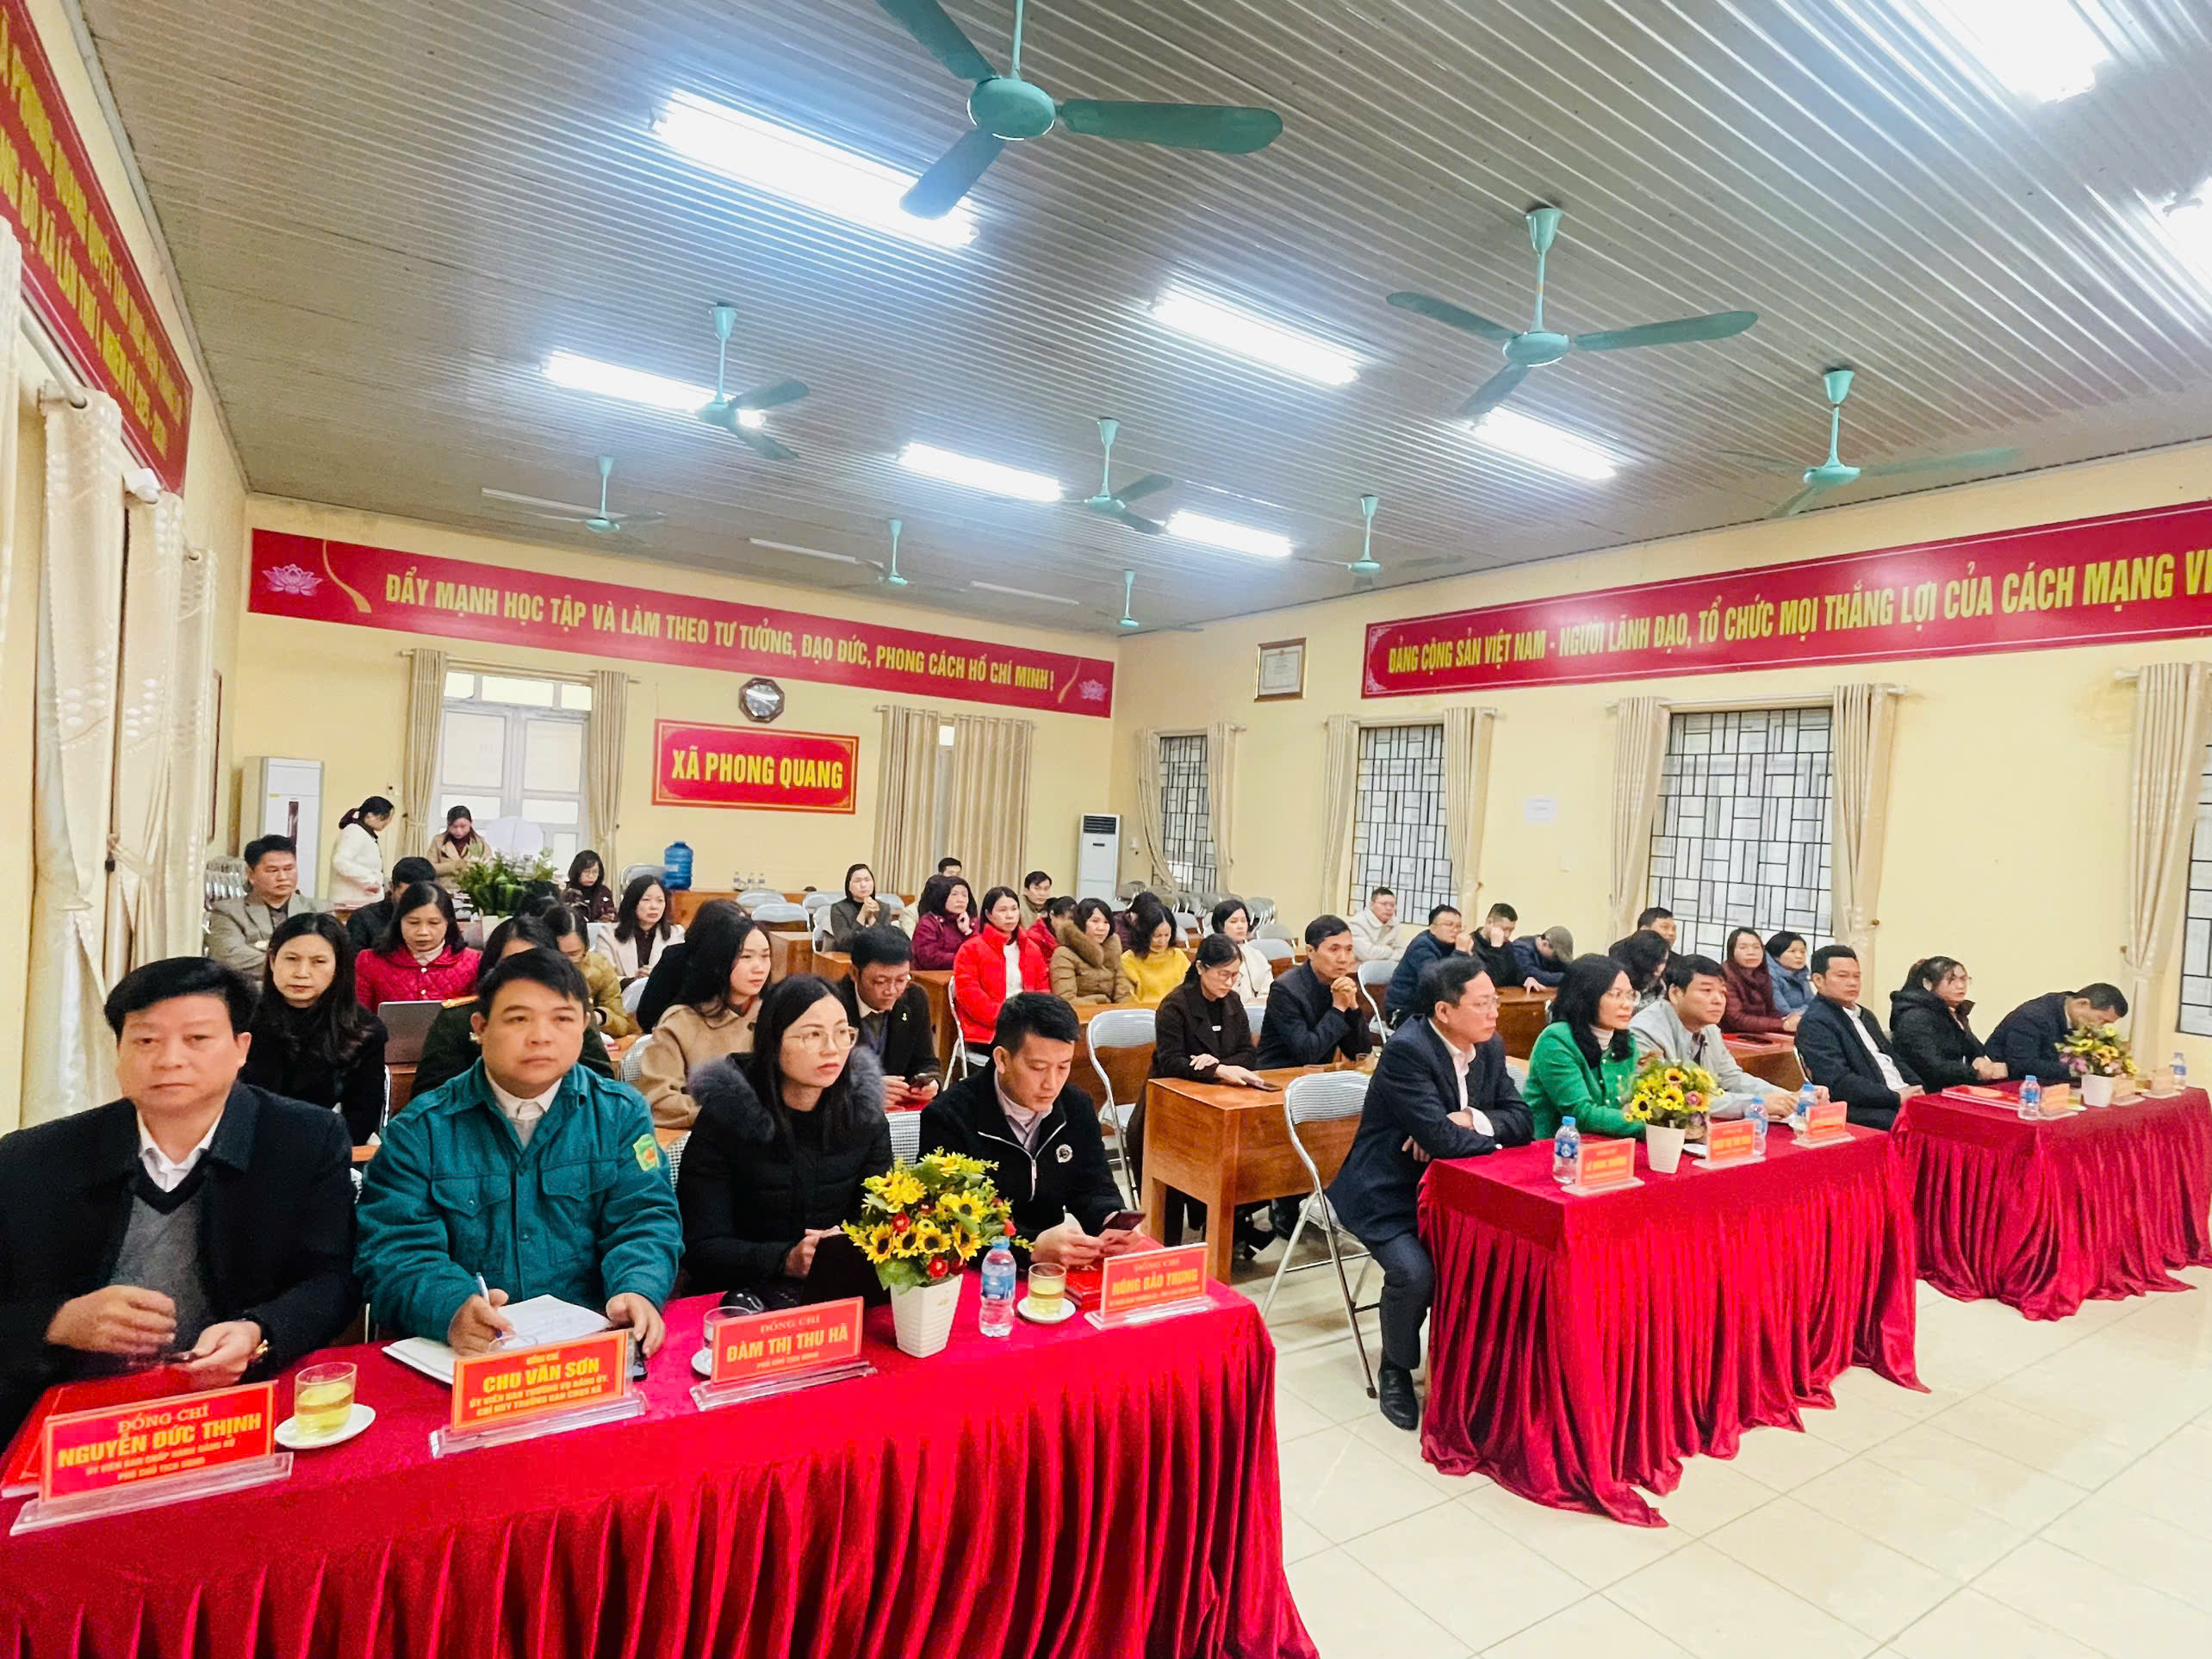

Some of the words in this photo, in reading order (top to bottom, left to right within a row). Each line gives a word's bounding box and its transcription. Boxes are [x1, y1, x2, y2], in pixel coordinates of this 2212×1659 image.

[385, 567, 428, 605] ĐẨY
[435, 581, 498, 618] MẠNH
[504, 592, 544, 624] HỌC
[550, 597, 587, 631] TẬP
[592, 600, 617, 631] VÀ
[621, 603, 660, 637] LÀM
[666, 612, 709, 643] THEO
[714, 620, 737, 648] TƯ
[739, 618, 797, 658] TƯỞNG,
[801, 635, 833, 664] ĐẠO
[837, 634, 872, 669] ĐỨC,
[876, 645, 924, 674] PHONG
[929, 650, 965, 680] CÁCH
[968, 653, 987, 681] HỒ
[990, 660, 1012, 686] CHÍ
[1388, 636, 1418, 674] ĐẢNG
[1421, 637, 1453, 675] CỘNG
[1456, 627, 1482, 667] SẢN
[1483, 627, 1512, 669] VIỆT
[1513, 630, 1545, 662] NAM
[1558, 615, 1605, 657] NGƯỜI
[1607, 614, 1649, 652] LÃNH
[1653, 612, 1692, 655] ĐẠO,
[1698, 595, 1723, 643] TỔ
[1724, 594, 1774, 640] CHỨC
[1780, 593, 1817, 642] MỌI
[1824, 579, 1893, 631] THẮNG
[1900, 581, 1936, 632] LỢI
[1944, 562, 1993, 620] CỦA
[2001, 561, 2075, 614] CÁCH
[2083, 554, 2174, 612] MẠNG
[2185, 548, 2212, 595] VI
[672, 745, 699, 780] XÃ
[705, 751, 774, 785] PHONG
[780, 757, 842, 789] QUANG
[727, 1340, 763, 1363] ĐÀM
[767, 1335, 792, 1355] THỊ
[796, 1330, 824, 1349] THU
[829, 1323, 848, 1343] HÀ
[483, 1372, 522, 1392] CHU
[525, 1364, 561, 1385] VĂN
[565, 1358, 600, 1377] SƠN
[177, 1404, 208, 1421] CHÍ
[58, 1432, 147, 1468] NGUYỄN
[152, 1424, 196, 1448] ĐỨC
[202, 1413, 262, 1440] THỊNH
